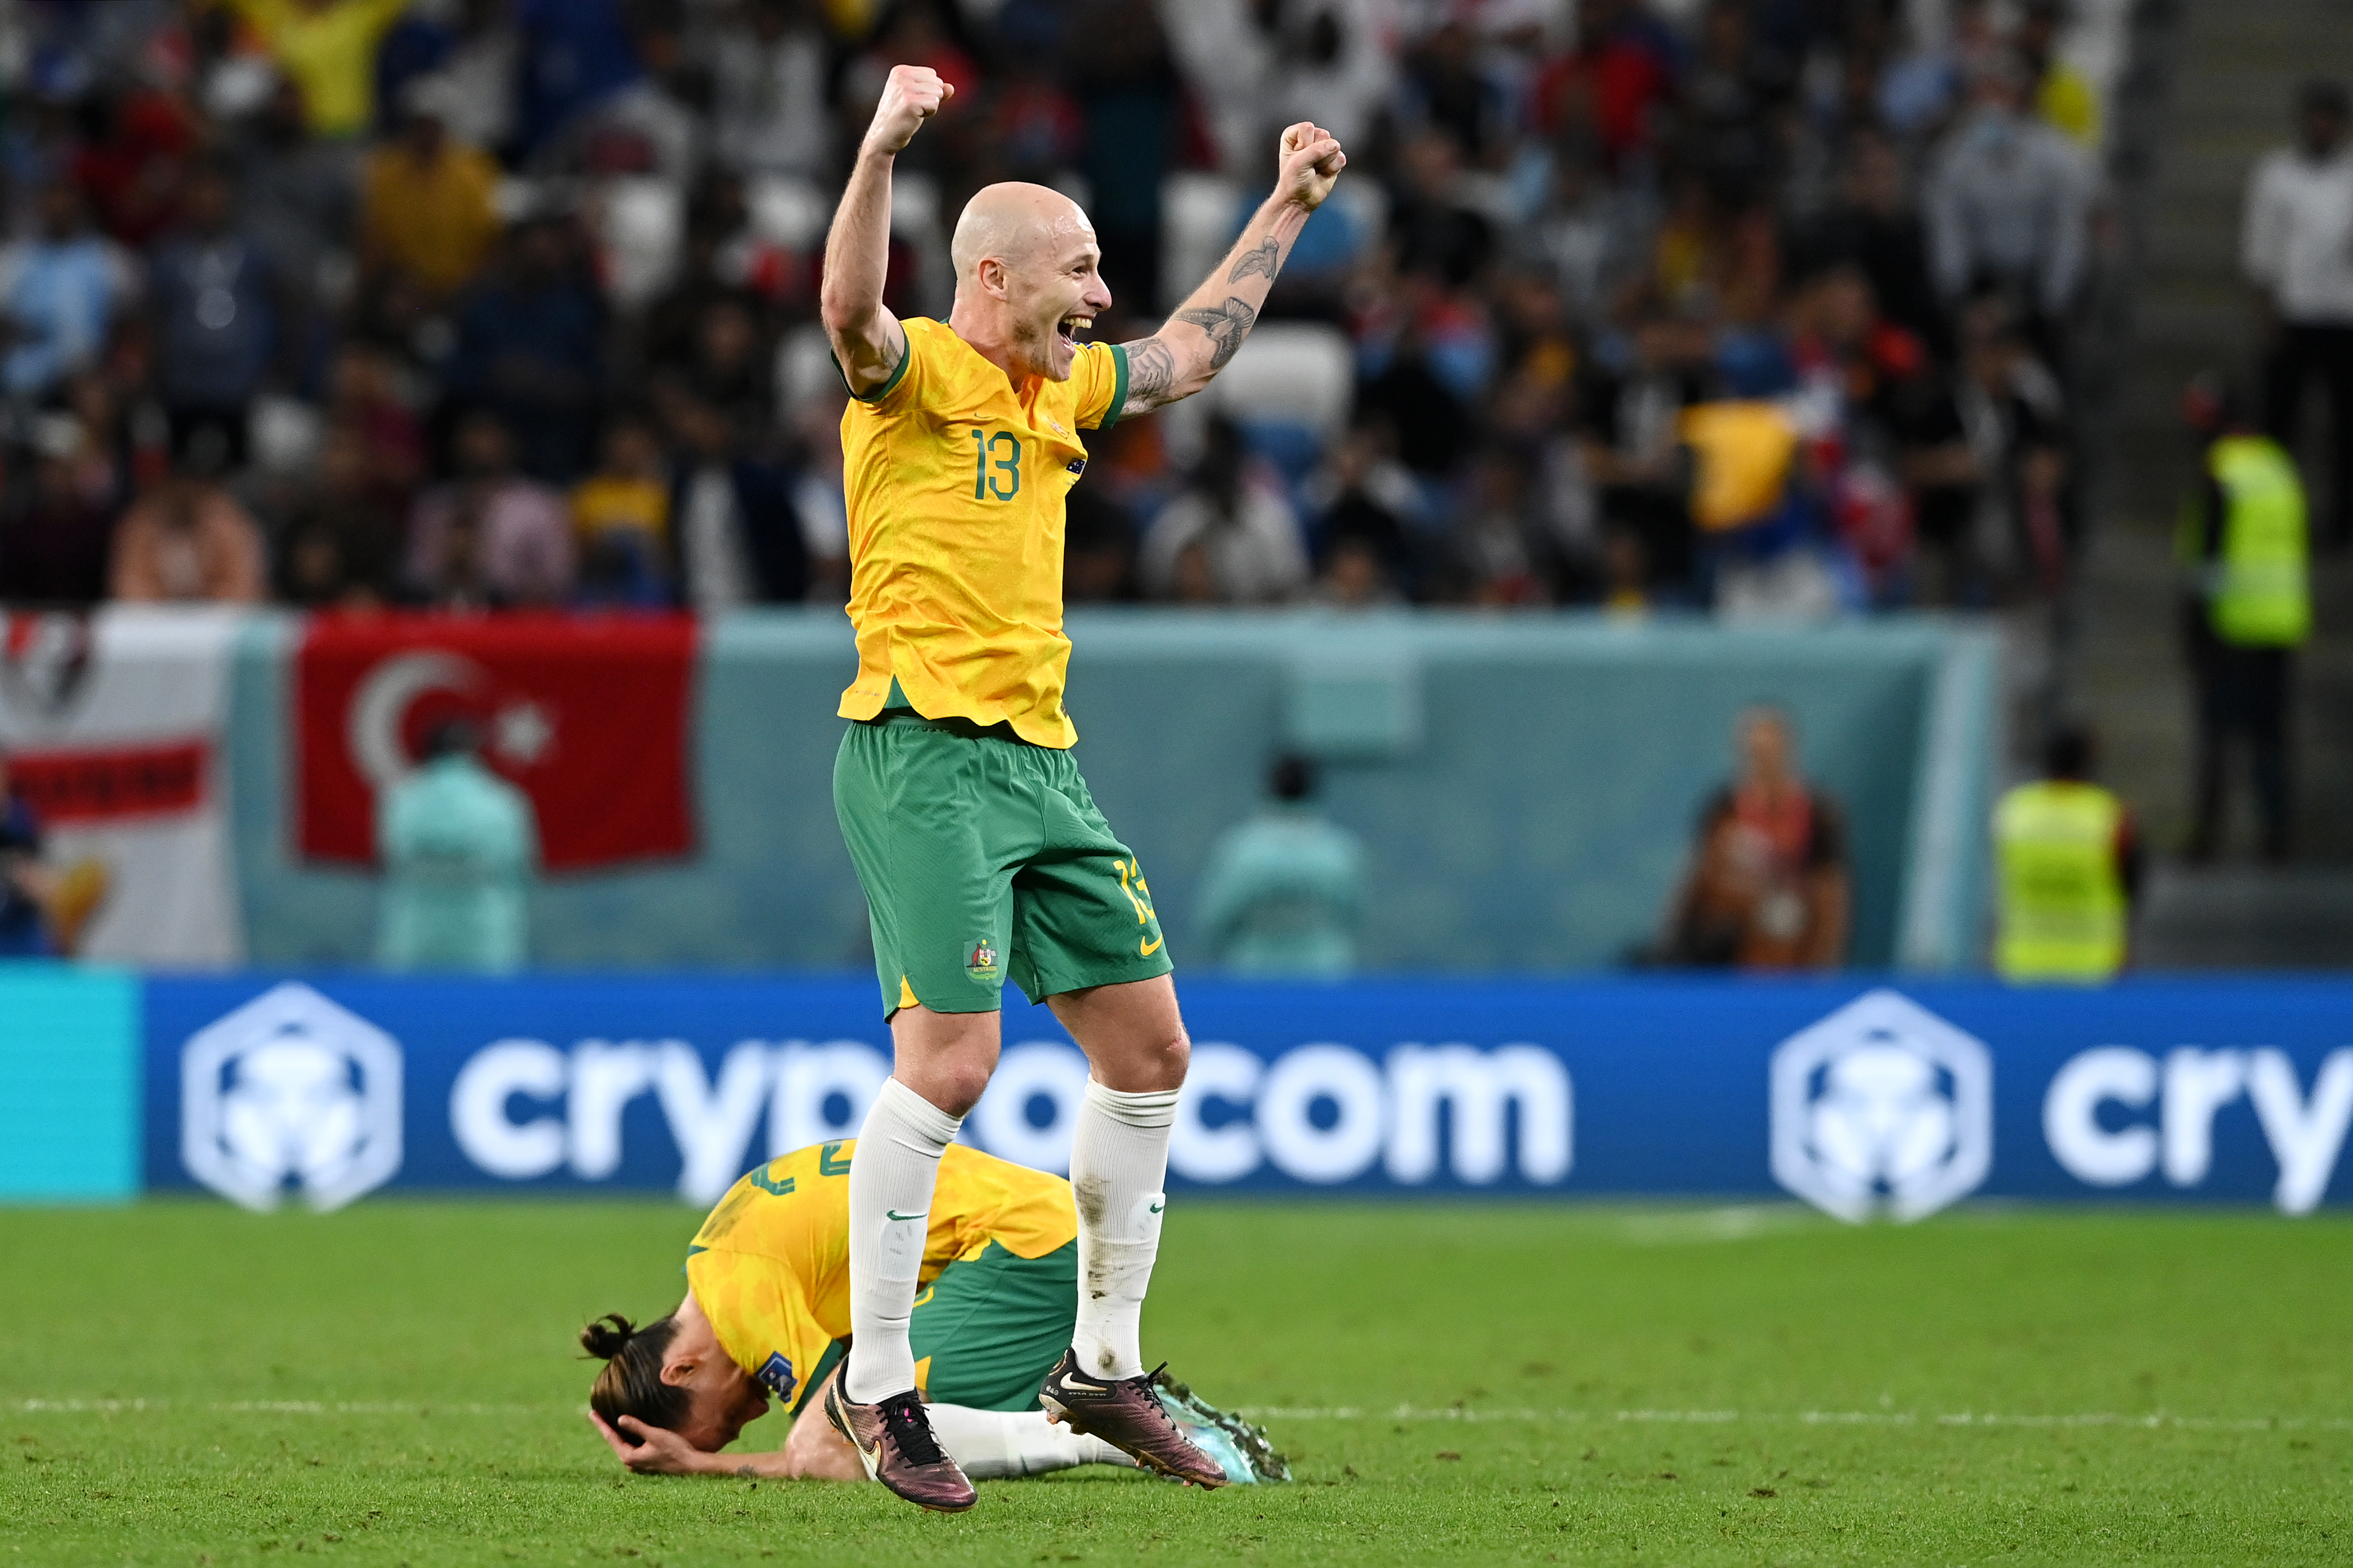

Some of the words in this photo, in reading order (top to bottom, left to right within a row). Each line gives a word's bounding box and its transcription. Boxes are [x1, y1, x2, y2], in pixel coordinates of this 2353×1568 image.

[972, 429, 1021, 501] 13
[451, 1040, 1572, 1206] crypocom
[2043, 1046, 2353, 1214] cry
